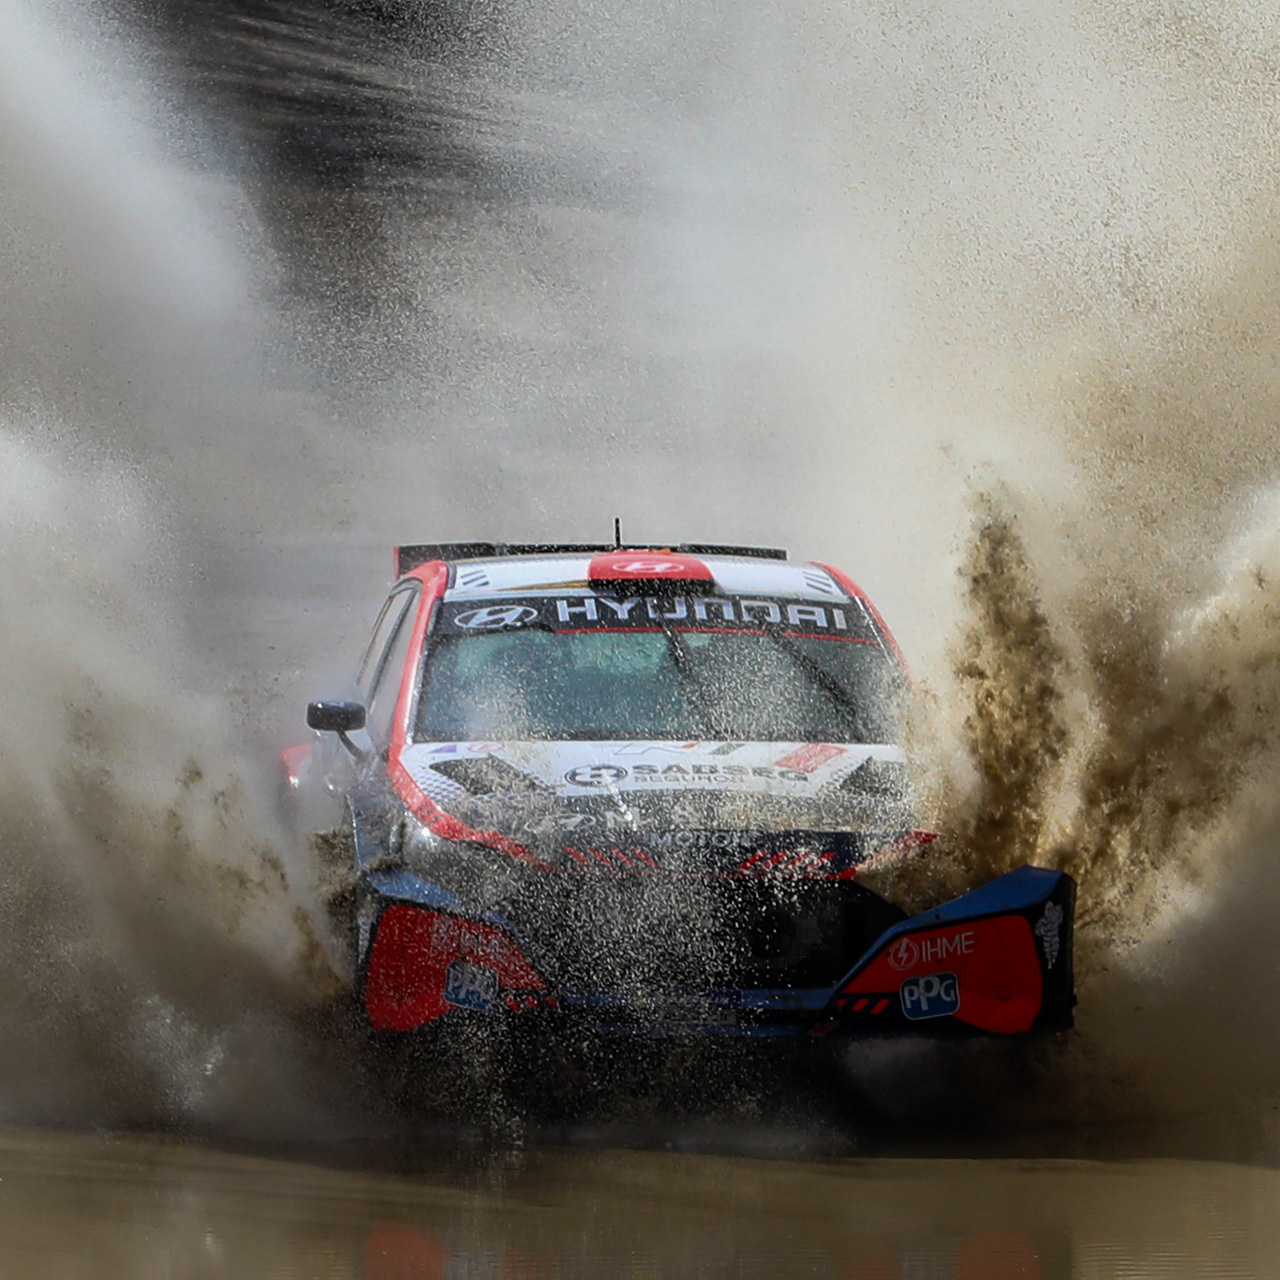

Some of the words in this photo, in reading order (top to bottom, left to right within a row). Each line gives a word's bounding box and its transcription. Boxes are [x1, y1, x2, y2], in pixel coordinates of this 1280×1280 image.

[556, 593, 847, 630] HYUNDAI
[922, 931, 975, 963] IHME
[904, 975, 956, 1011] PPG
